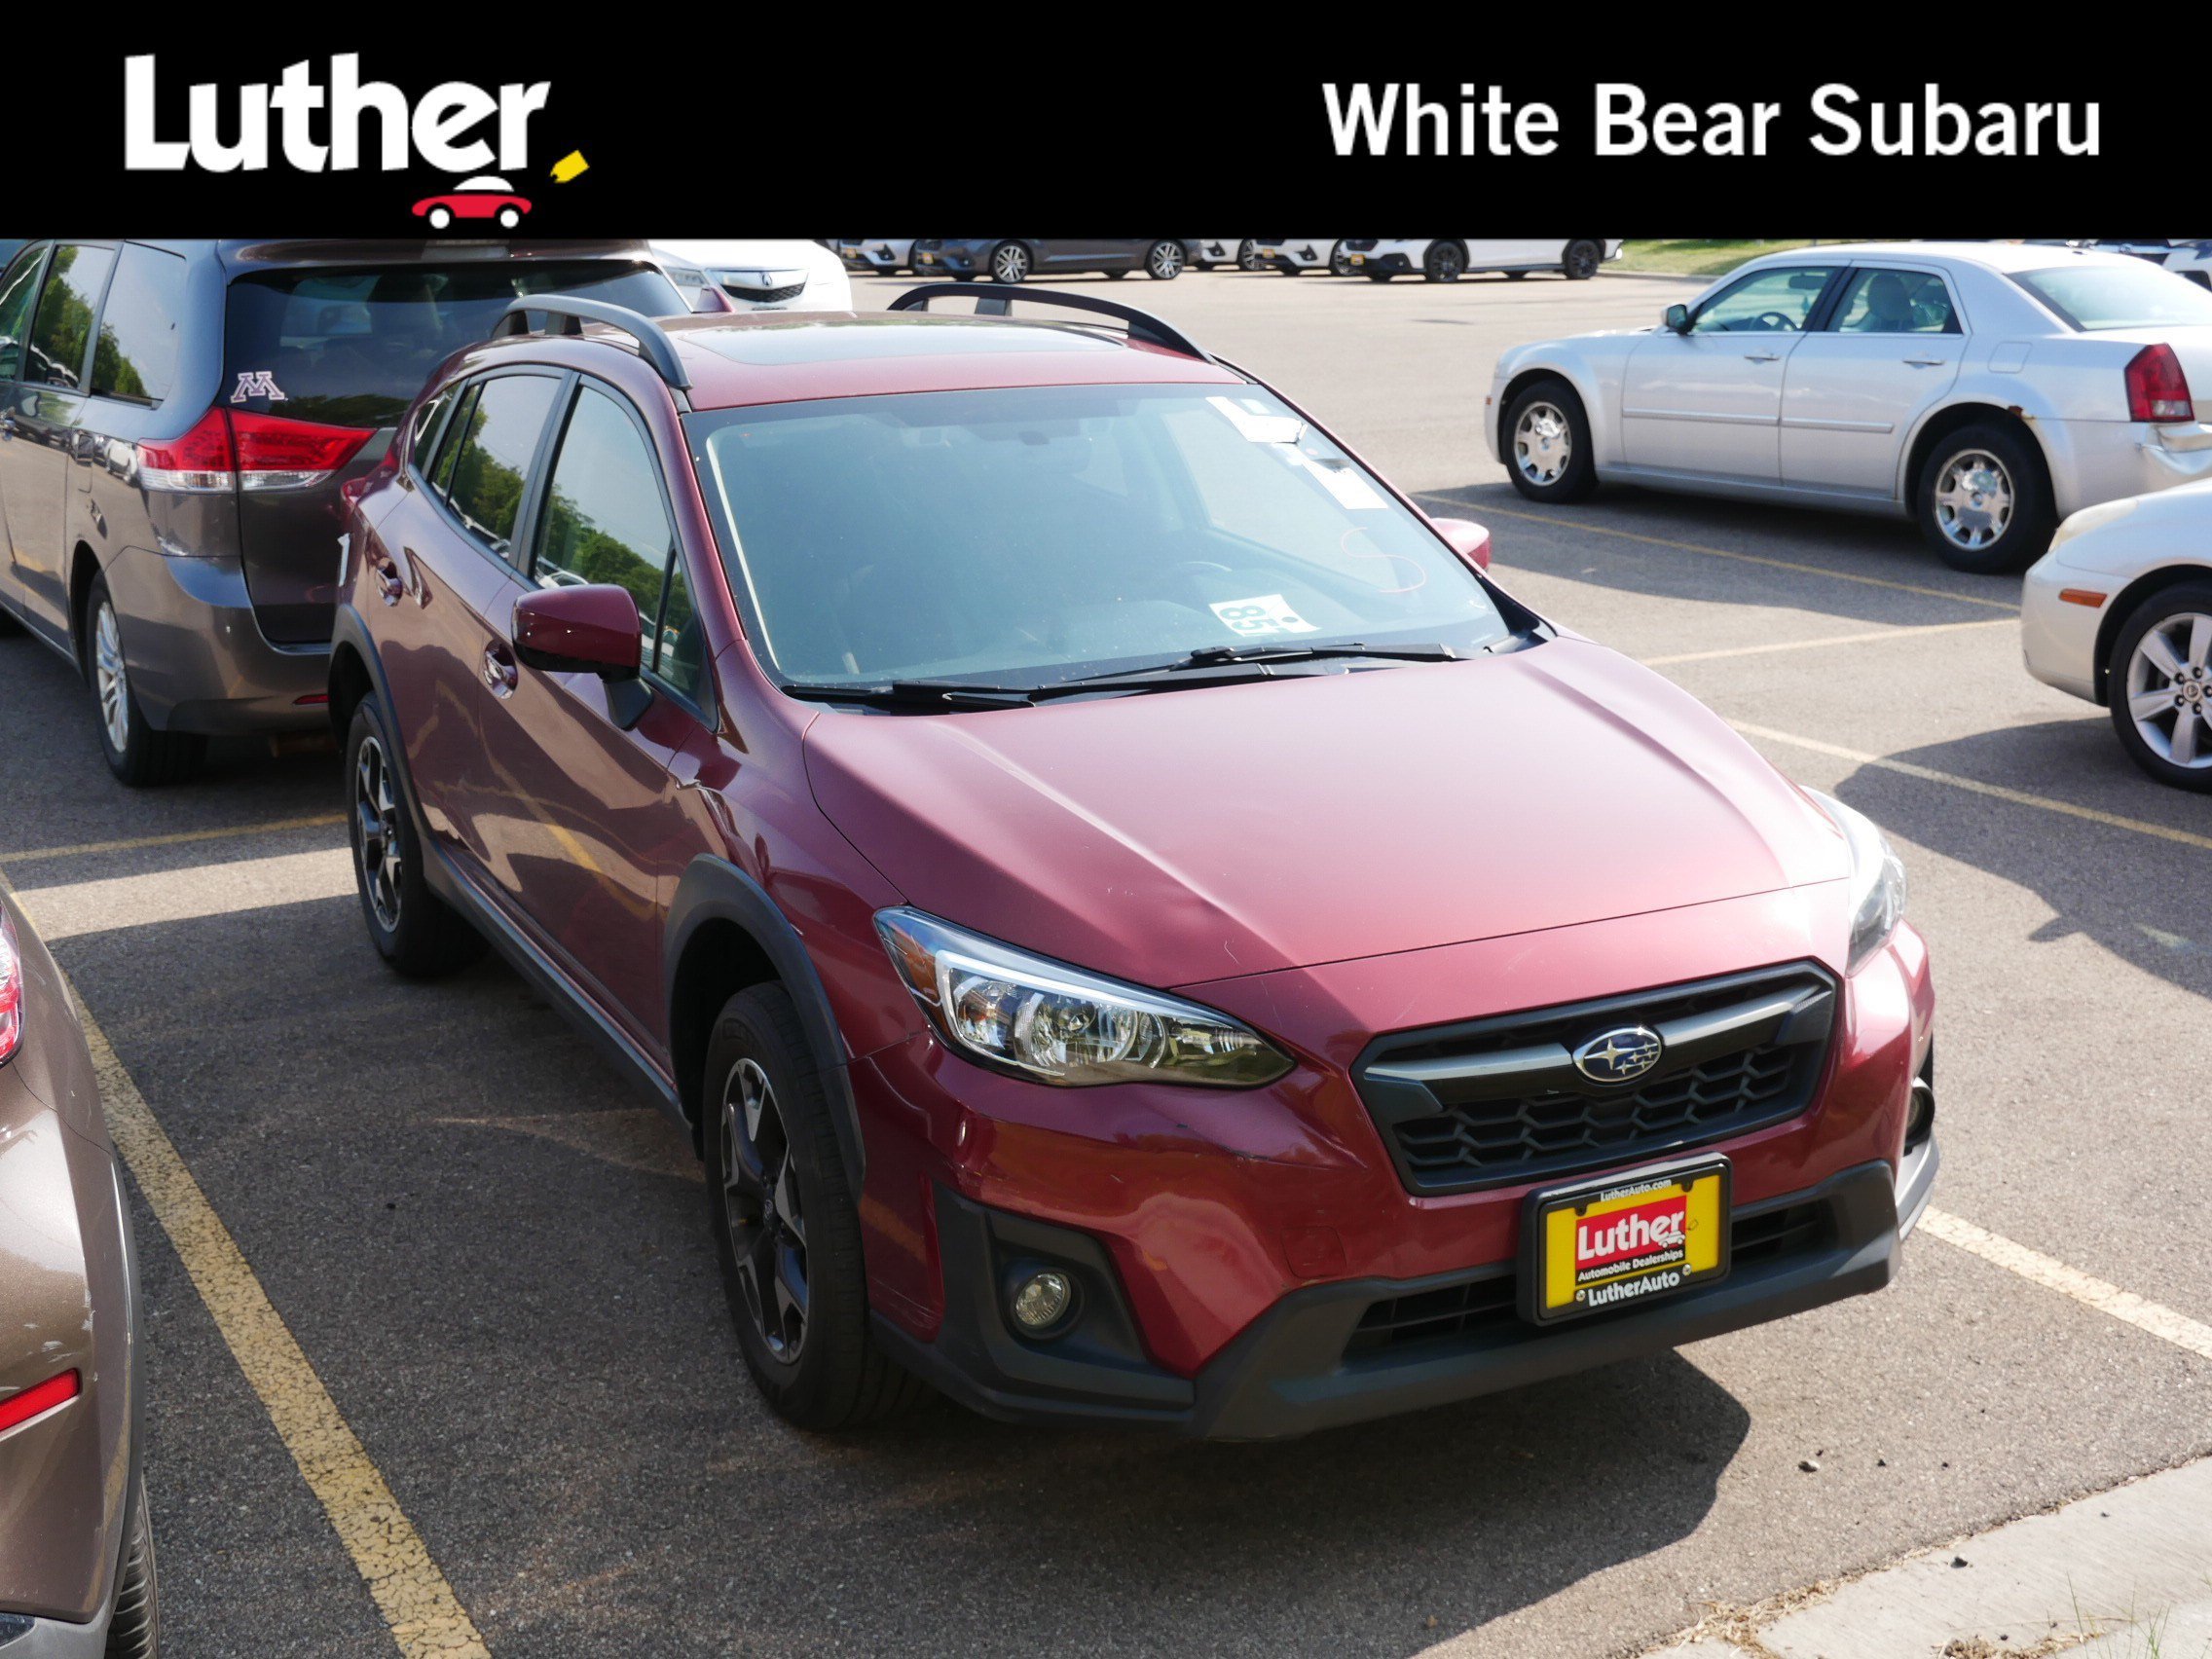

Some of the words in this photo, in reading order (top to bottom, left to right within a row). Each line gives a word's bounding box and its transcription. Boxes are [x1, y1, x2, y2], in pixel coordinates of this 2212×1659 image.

[1600, 1179, 1673, 1201] LutherAuto.com
[1577, 1210, 1685, 1261] Luther
[1577, 1262, 1632, 1282] Automobile
[1632, 1248, 1684, 1269] Dealerships
[1588, 1272, 1680, 1307] LutherAuto
